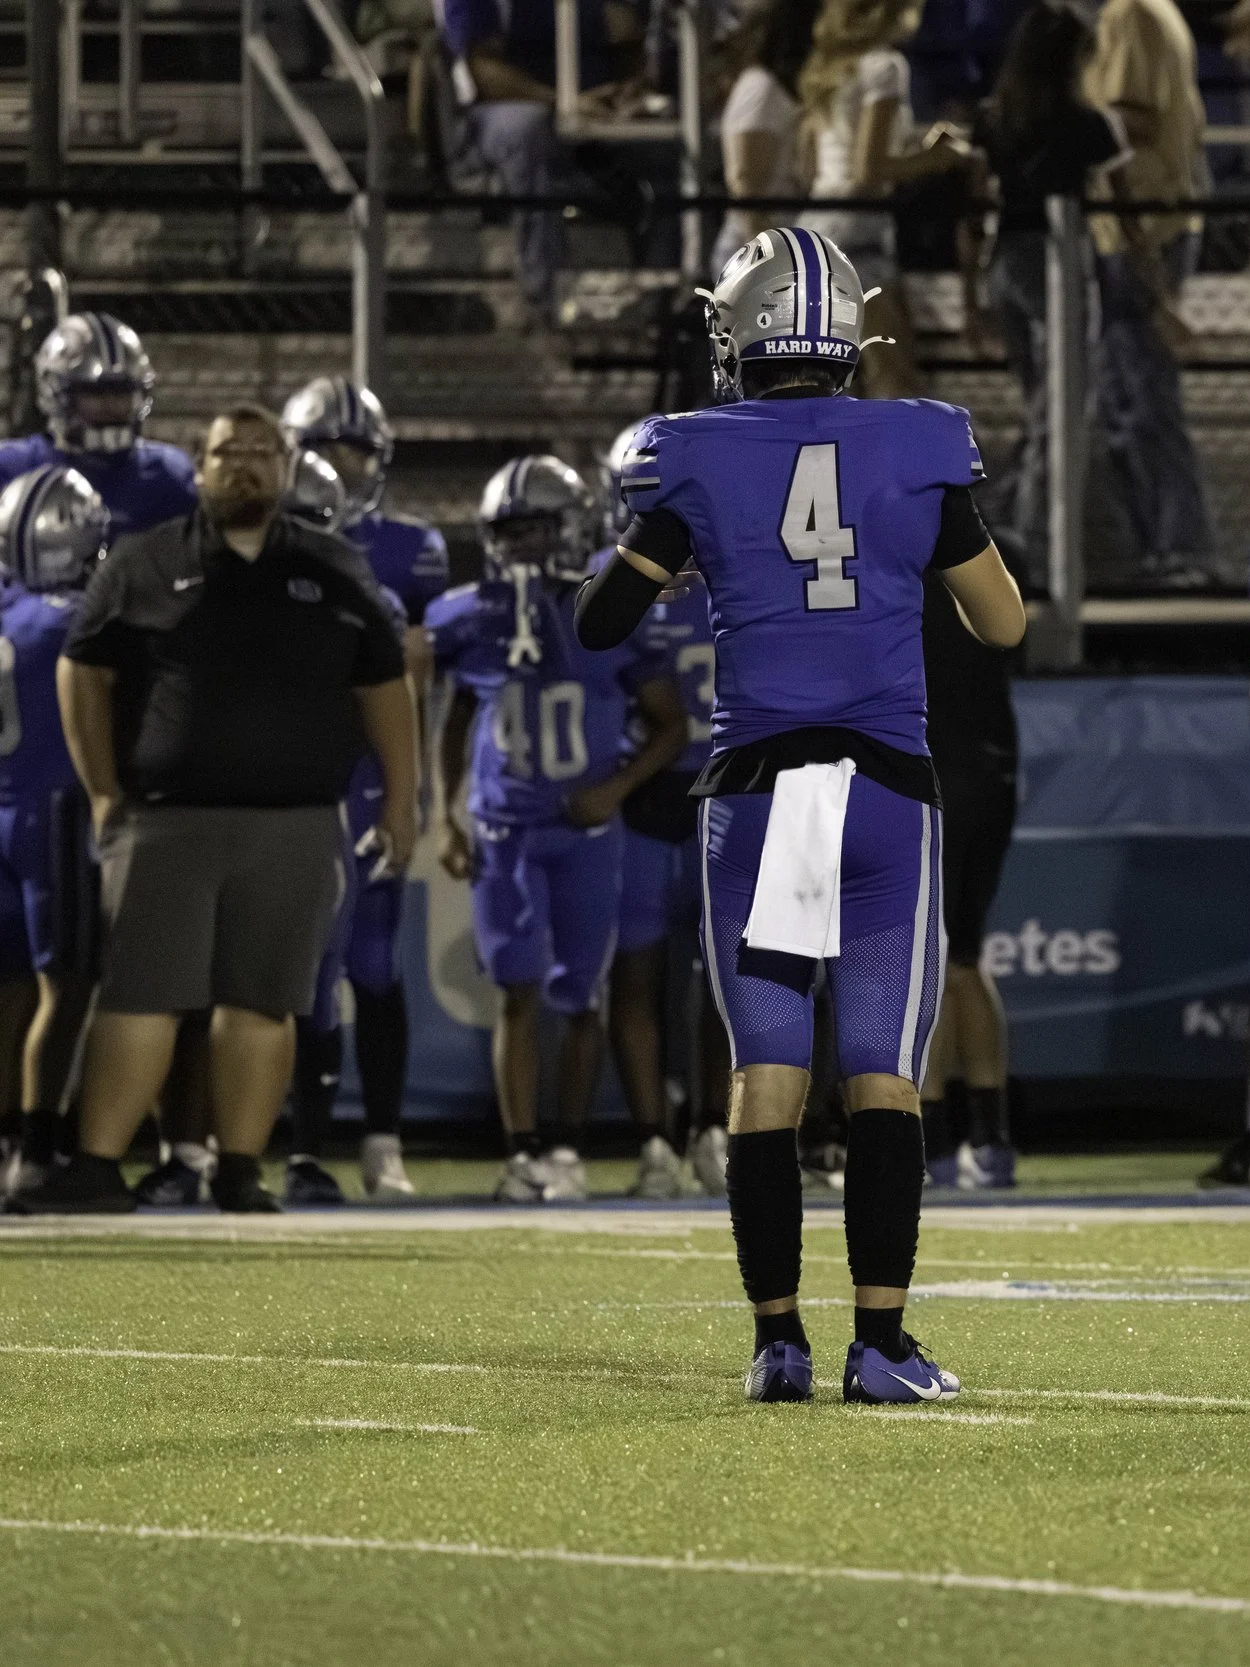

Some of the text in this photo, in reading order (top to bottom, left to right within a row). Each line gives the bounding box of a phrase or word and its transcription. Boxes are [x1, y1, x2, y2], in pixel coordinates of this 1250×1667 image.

[760, 314, 767, 326] 4
[764, 340, 853, 358] HARD WAY
[778, 440, 860, 614] 4
[493, 681, 589, 781] 40
